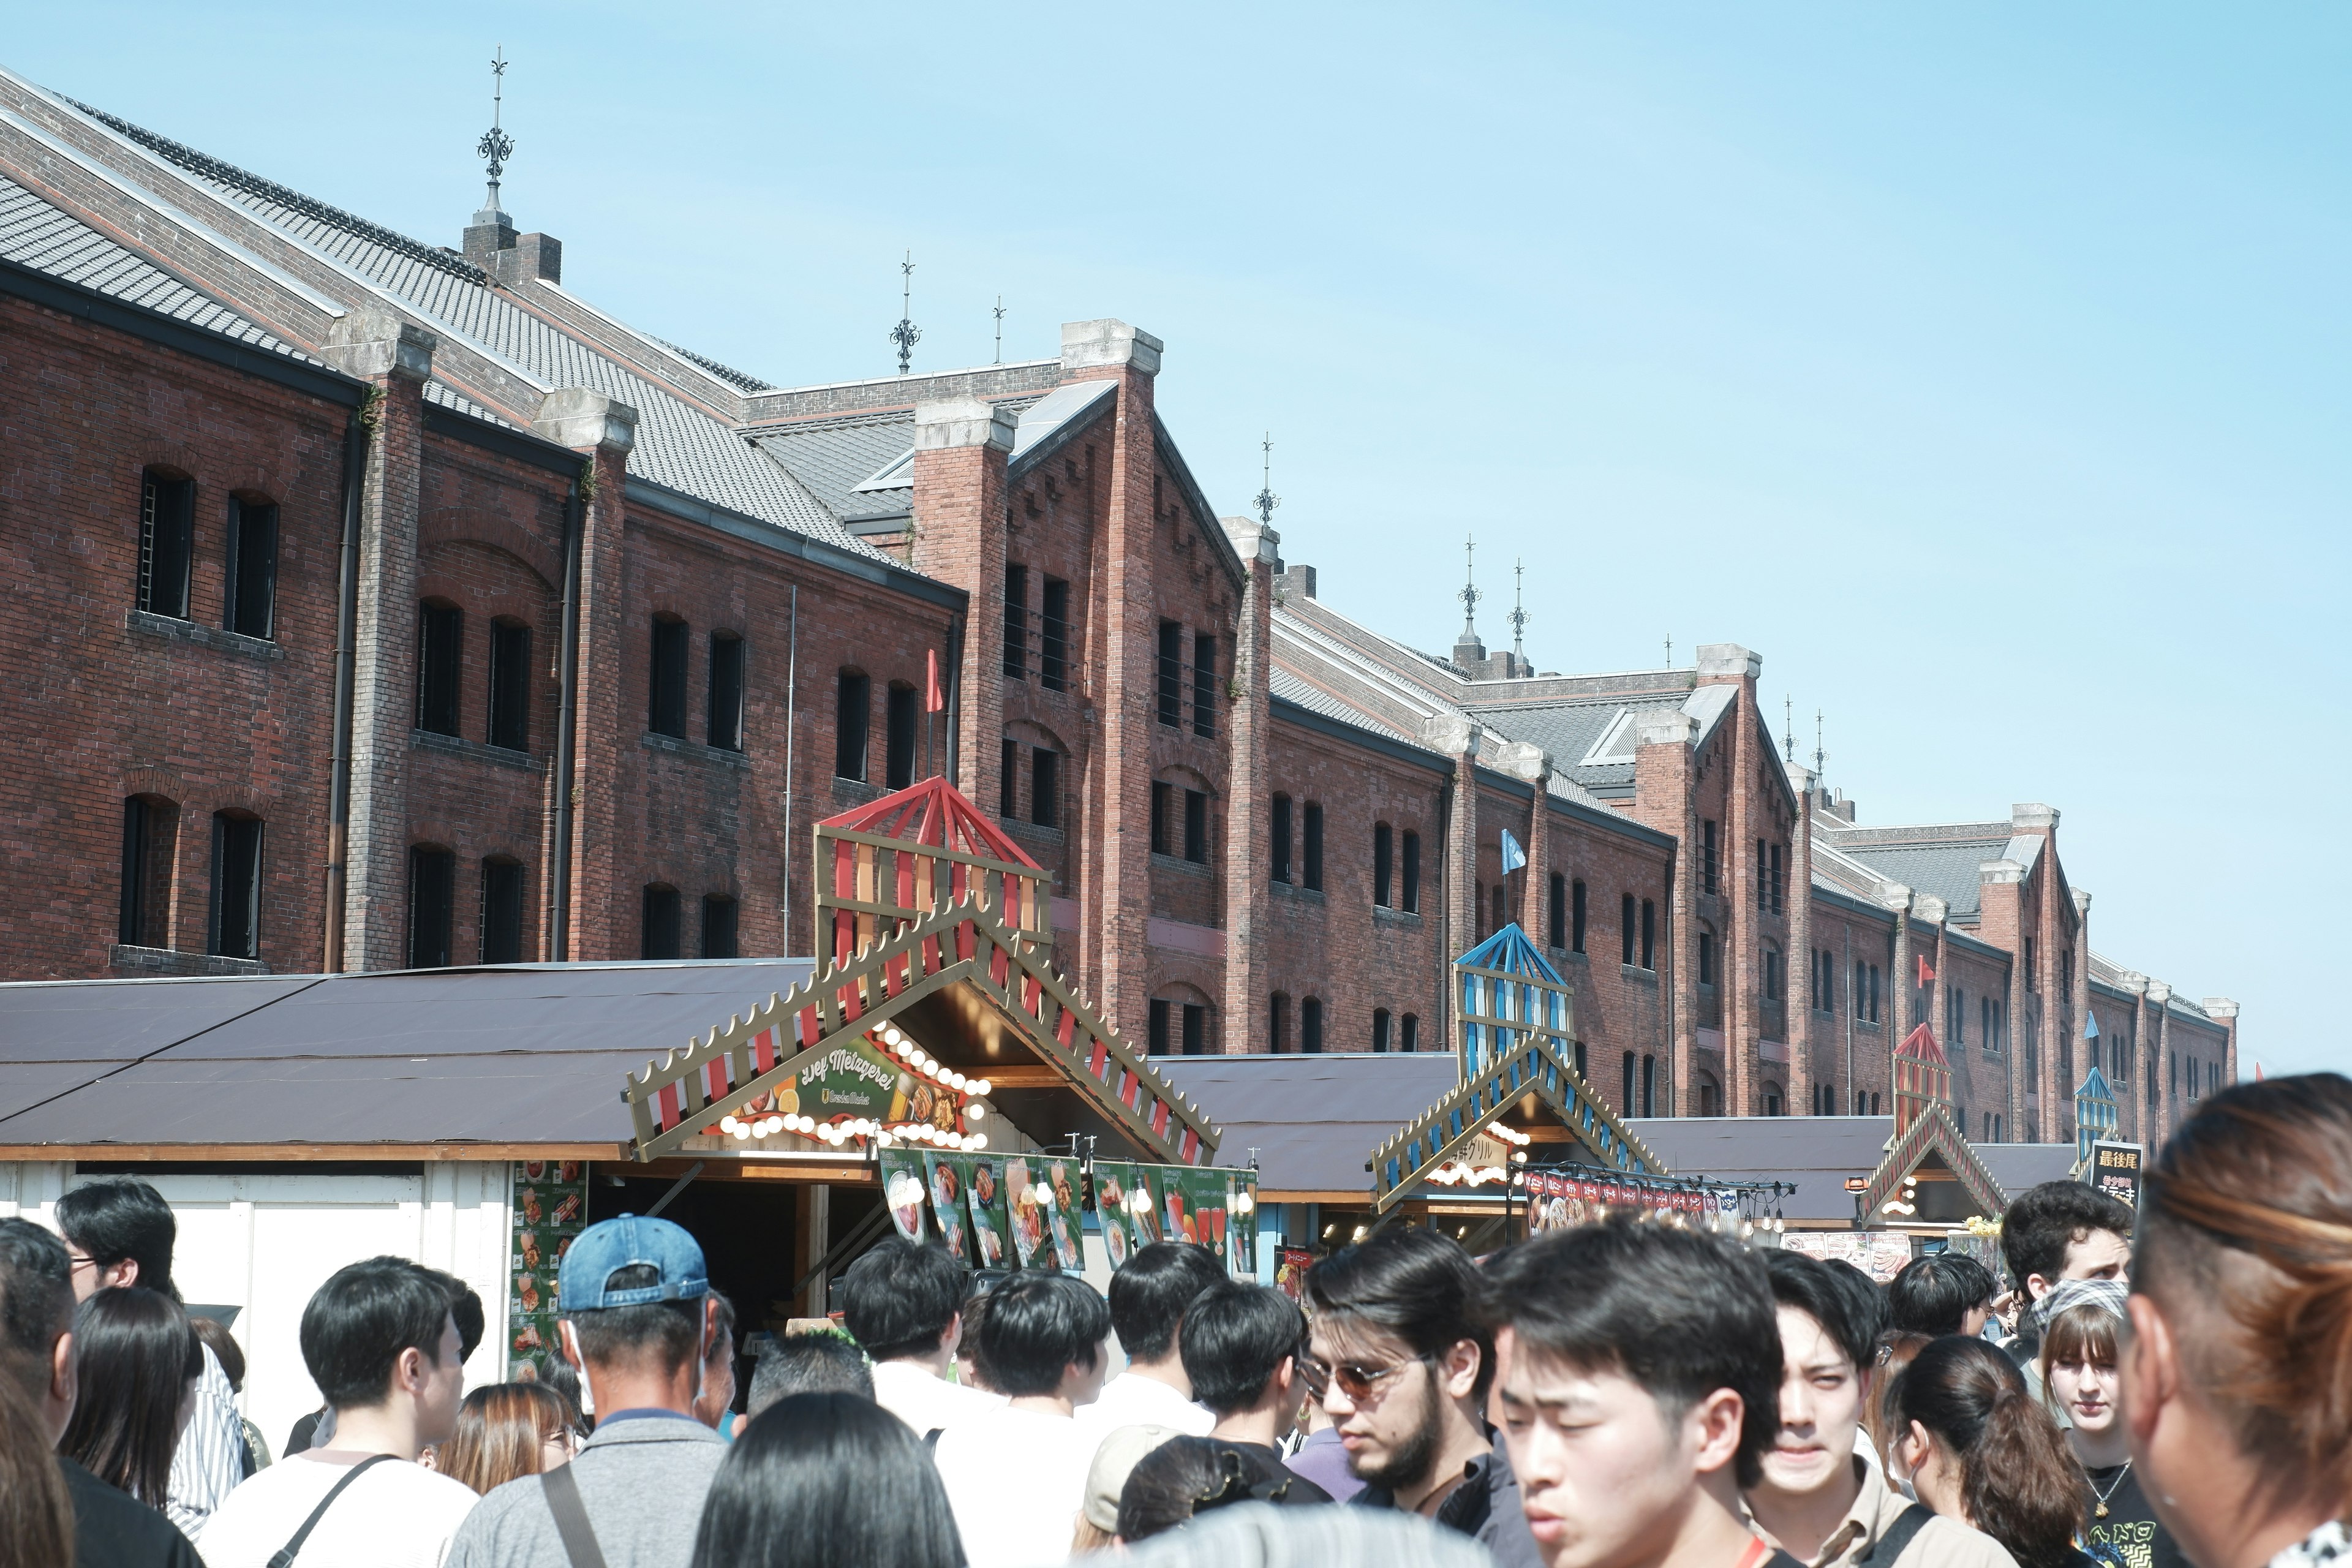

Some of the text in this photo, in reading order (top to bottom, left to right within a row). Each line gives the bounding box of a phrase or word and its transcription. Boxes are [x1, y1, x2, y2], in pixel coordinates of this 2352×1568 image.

[2099, 1150, 2137, 1169] 最後尾
[2103, 1175, 2132, 1188] 希少部位
[1566, 1183, 1577, 1194] ポテト
[1584, 1186, 1597, 1196] ステーキ
[1604, 1189, 1616, 1199] ステーキ
[2098, 1185, 2135, 1200] ステーキ
[2088, 1521, 2156, 1545] ヘドロ
